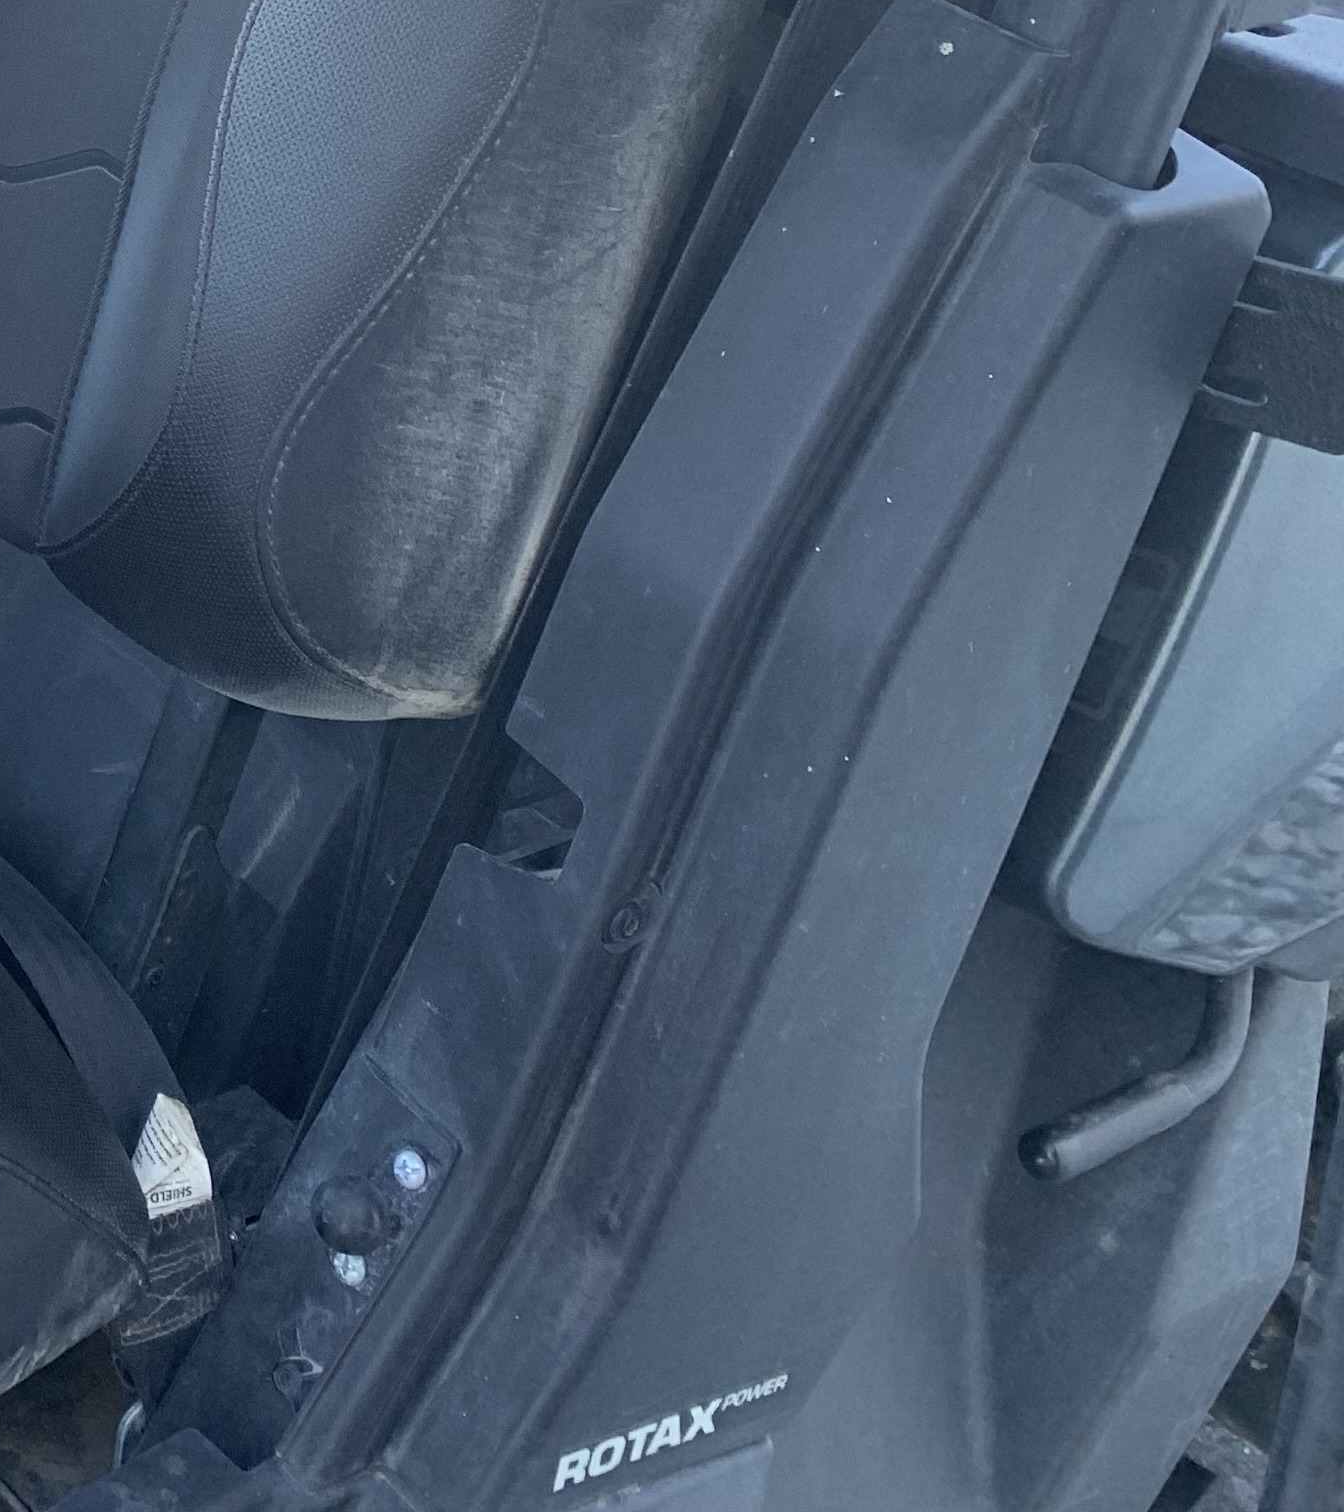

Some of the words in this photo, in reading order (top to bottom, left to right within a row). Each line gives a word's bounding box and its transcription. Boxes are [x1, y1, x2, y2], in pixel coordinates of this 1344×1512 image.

[150, 1187, 192, 1203] SHIELD
[552, 1397, 722, 1494] ROTAX
[720, 1373, 789, 1412] POWER
